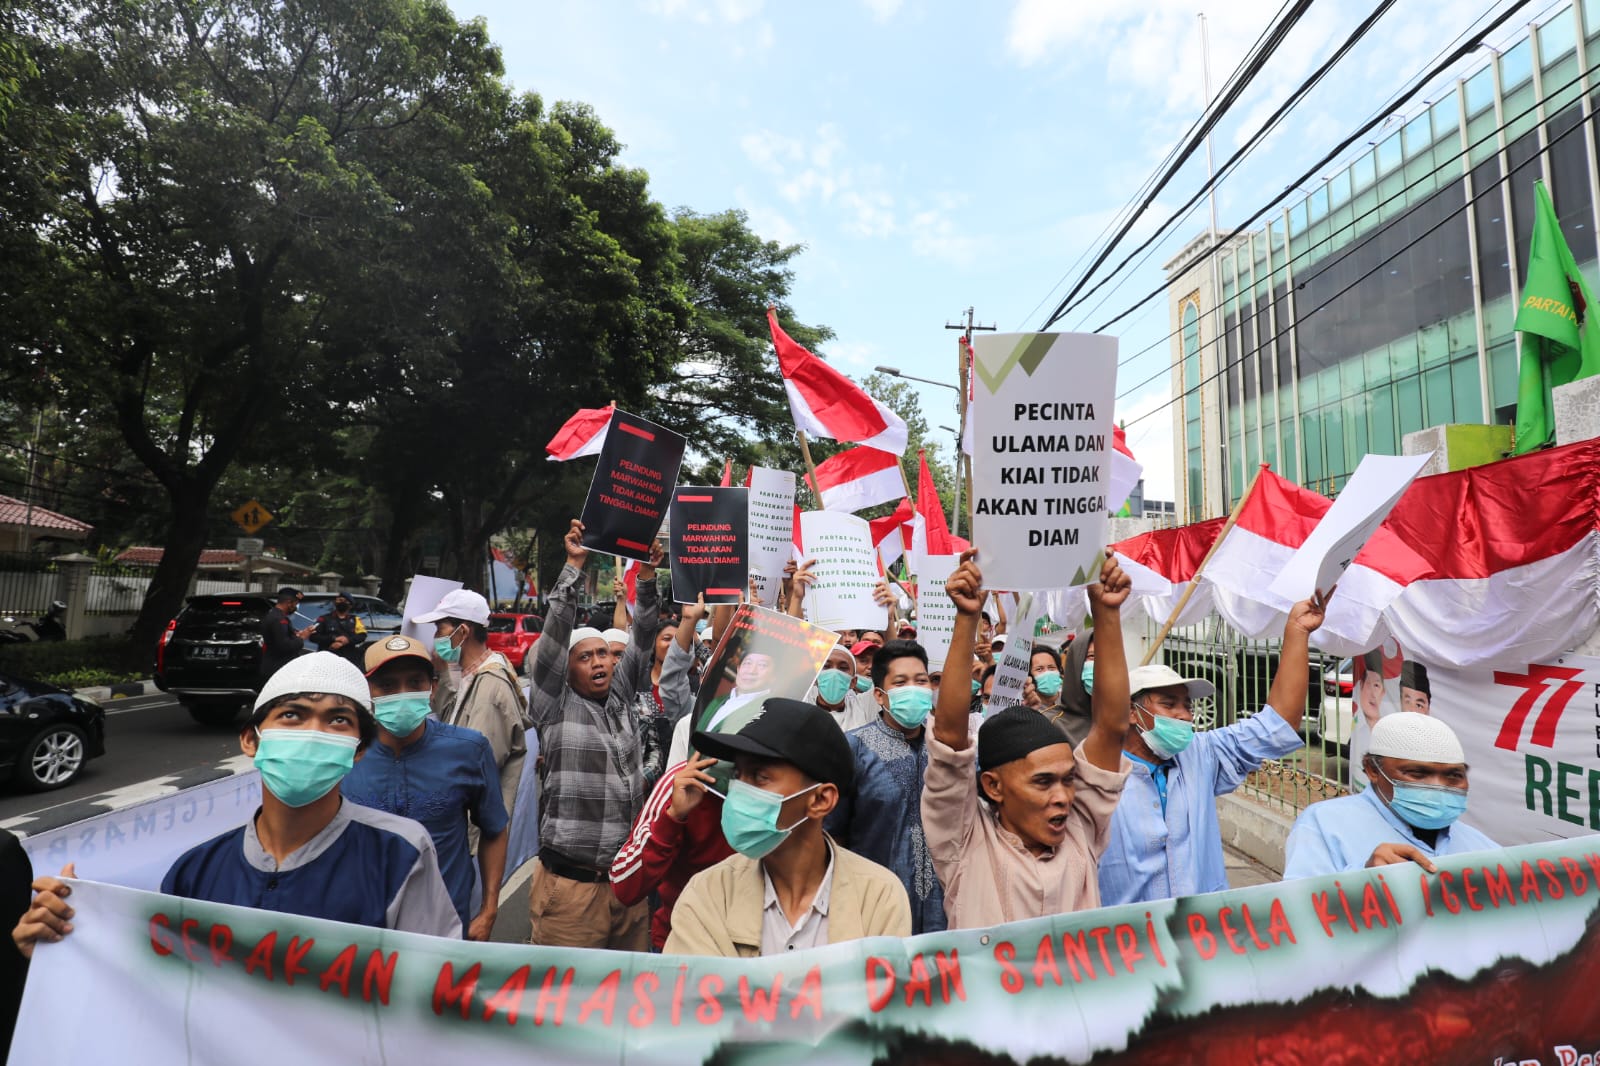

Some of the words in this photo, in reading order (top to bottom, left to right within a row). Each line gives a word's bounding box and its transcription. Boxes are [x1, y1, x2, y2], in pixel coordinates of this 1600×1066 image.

[1524, 296, 1570, 318] PARTAI
[1014, 403, 1095, 421] PECINTA
[992, 435, 1069, 453] ULAMA
[1075, 434, 1105, 452] DAN
[619, 459, 662, 480] PELINDUNG
[1001, 467, 1044, 484] KIAI
[1051, 465, 1099, 484] TIDAK
[610, 470, 648, 489] MARWAH
[648, 482, 664, 495] KIAI
[599, 494, 634, 512] TINGGAL
[612, 484, 635, 498] TIDAK
[635, 492, 656, 505] AKAN
[976, 498, 1037, 516] AKAN
[687, 523, 731, 531] PELINDUNG
[682, 534, 720, 542] MARWAH
[721, 534, 736, 542] KIAI
[1028, 528, 1079, 547] DIAM
[687, 545, 709, 553] TIDAK
[710, 545, 733, 553] AKAN
[679, 556, 713, 564] TINGGAL
[713, 556, 740, 564] DIAM!!!
[1494, 663, 1585, 752] 77
[149, 912, 399, 1006] GERAKAN
[864, 947, 968, 1013] DAN
[1186, 897, 1297, 961] BELA
